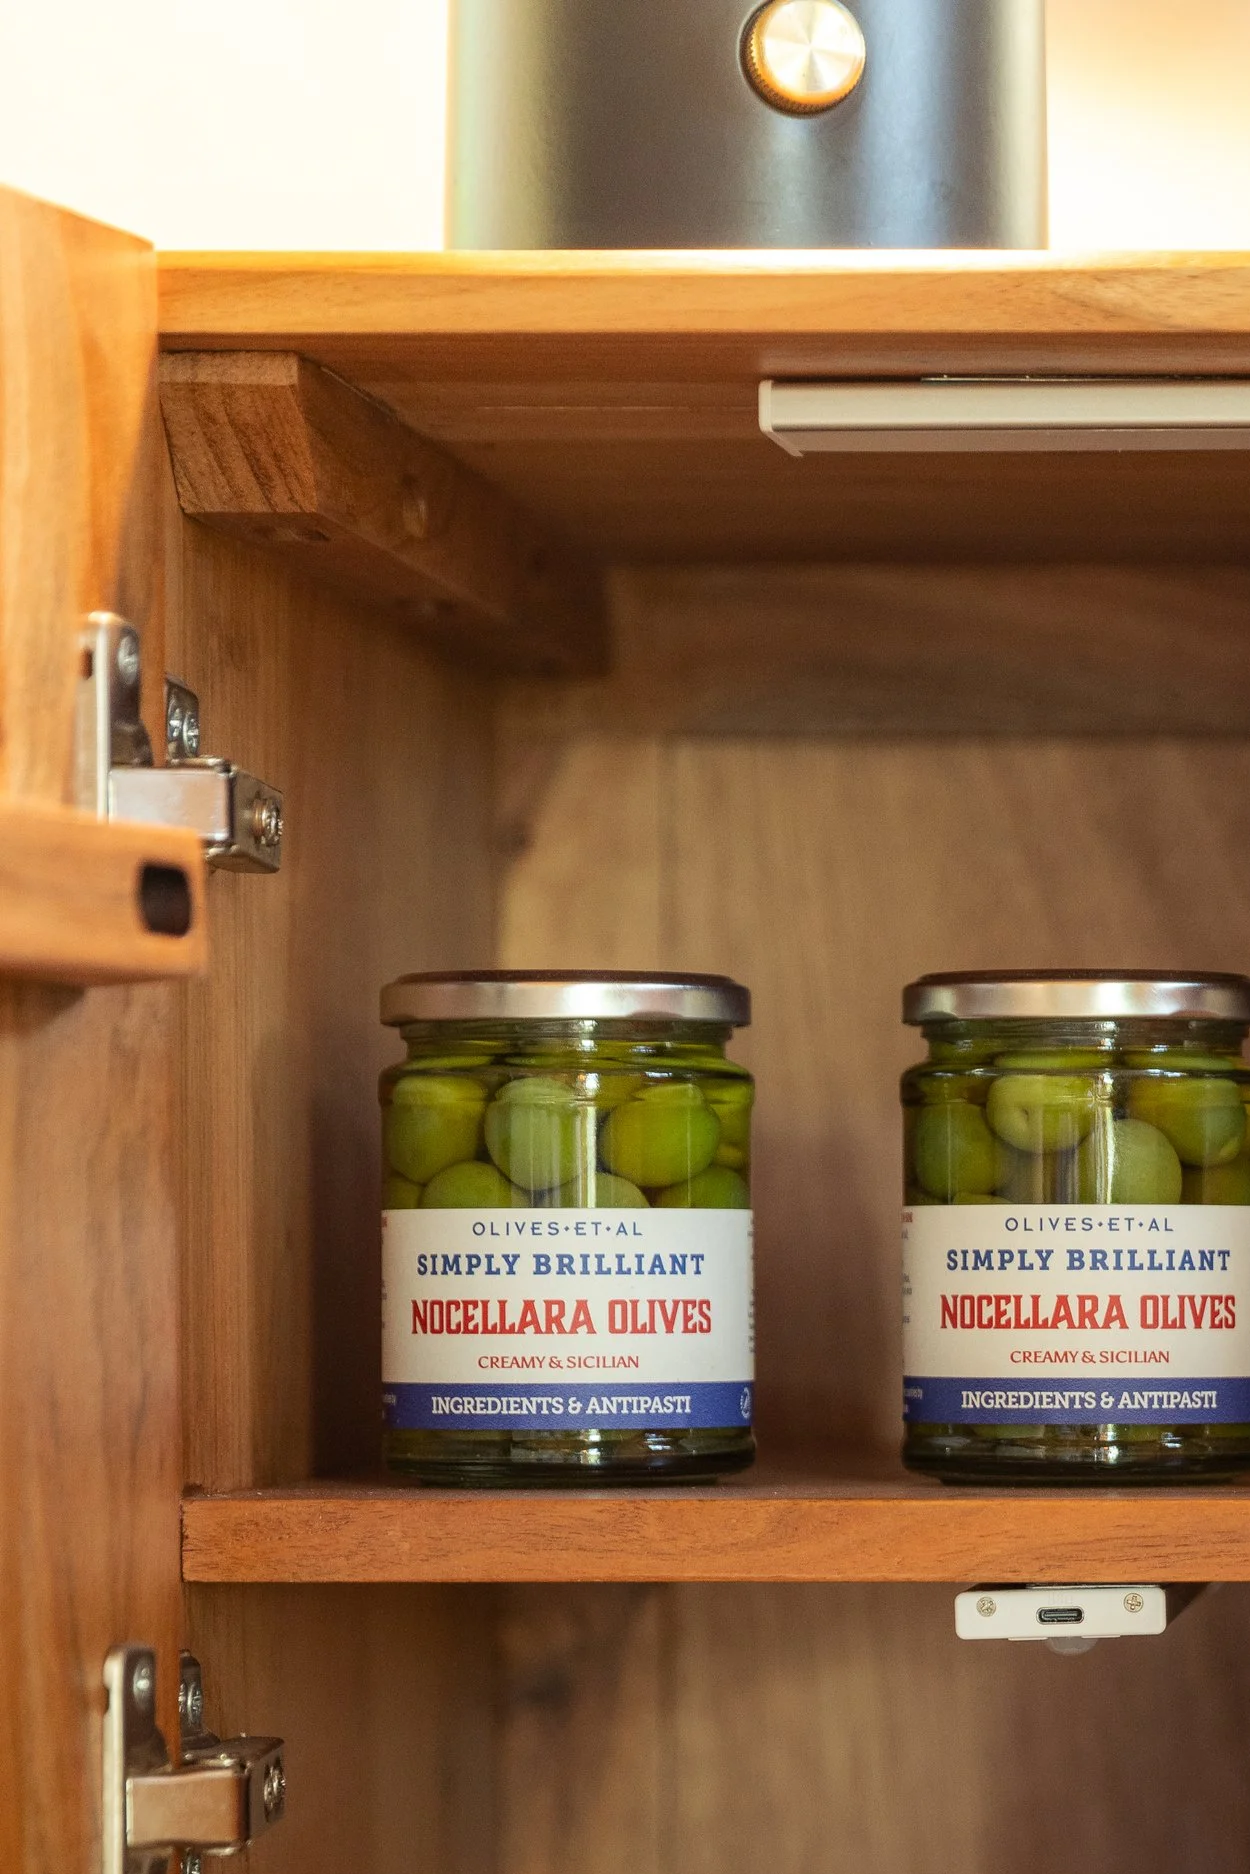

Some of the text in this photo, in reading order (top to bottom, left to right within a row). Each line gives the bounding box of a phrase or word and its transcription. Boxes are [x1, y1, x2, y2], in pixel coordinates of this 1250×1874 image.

[417, 1254, 705, 1275] SIMPLY BRILLIANT
[946, 1249, 1230, 1271] SIMPLY BRILLIANT
[411, 1299, 712, 1334] NOCELLARA OLIVES
[940, 1294, 1129, 1329] NOCELLARA
[1140, 1294, 1236, 1329] OLIVES
[478, 1356, 639, 1369] CREAMY & SICILIAN
[1010, 1350, 1170, 1364] CREAMY & SICILIAN
[432, 1395, 691, 1415] INGREDIENTS & ANTIPASTI
[961, 1391, 1217, 1409] INGREDIENTS & ANTIPASTI
